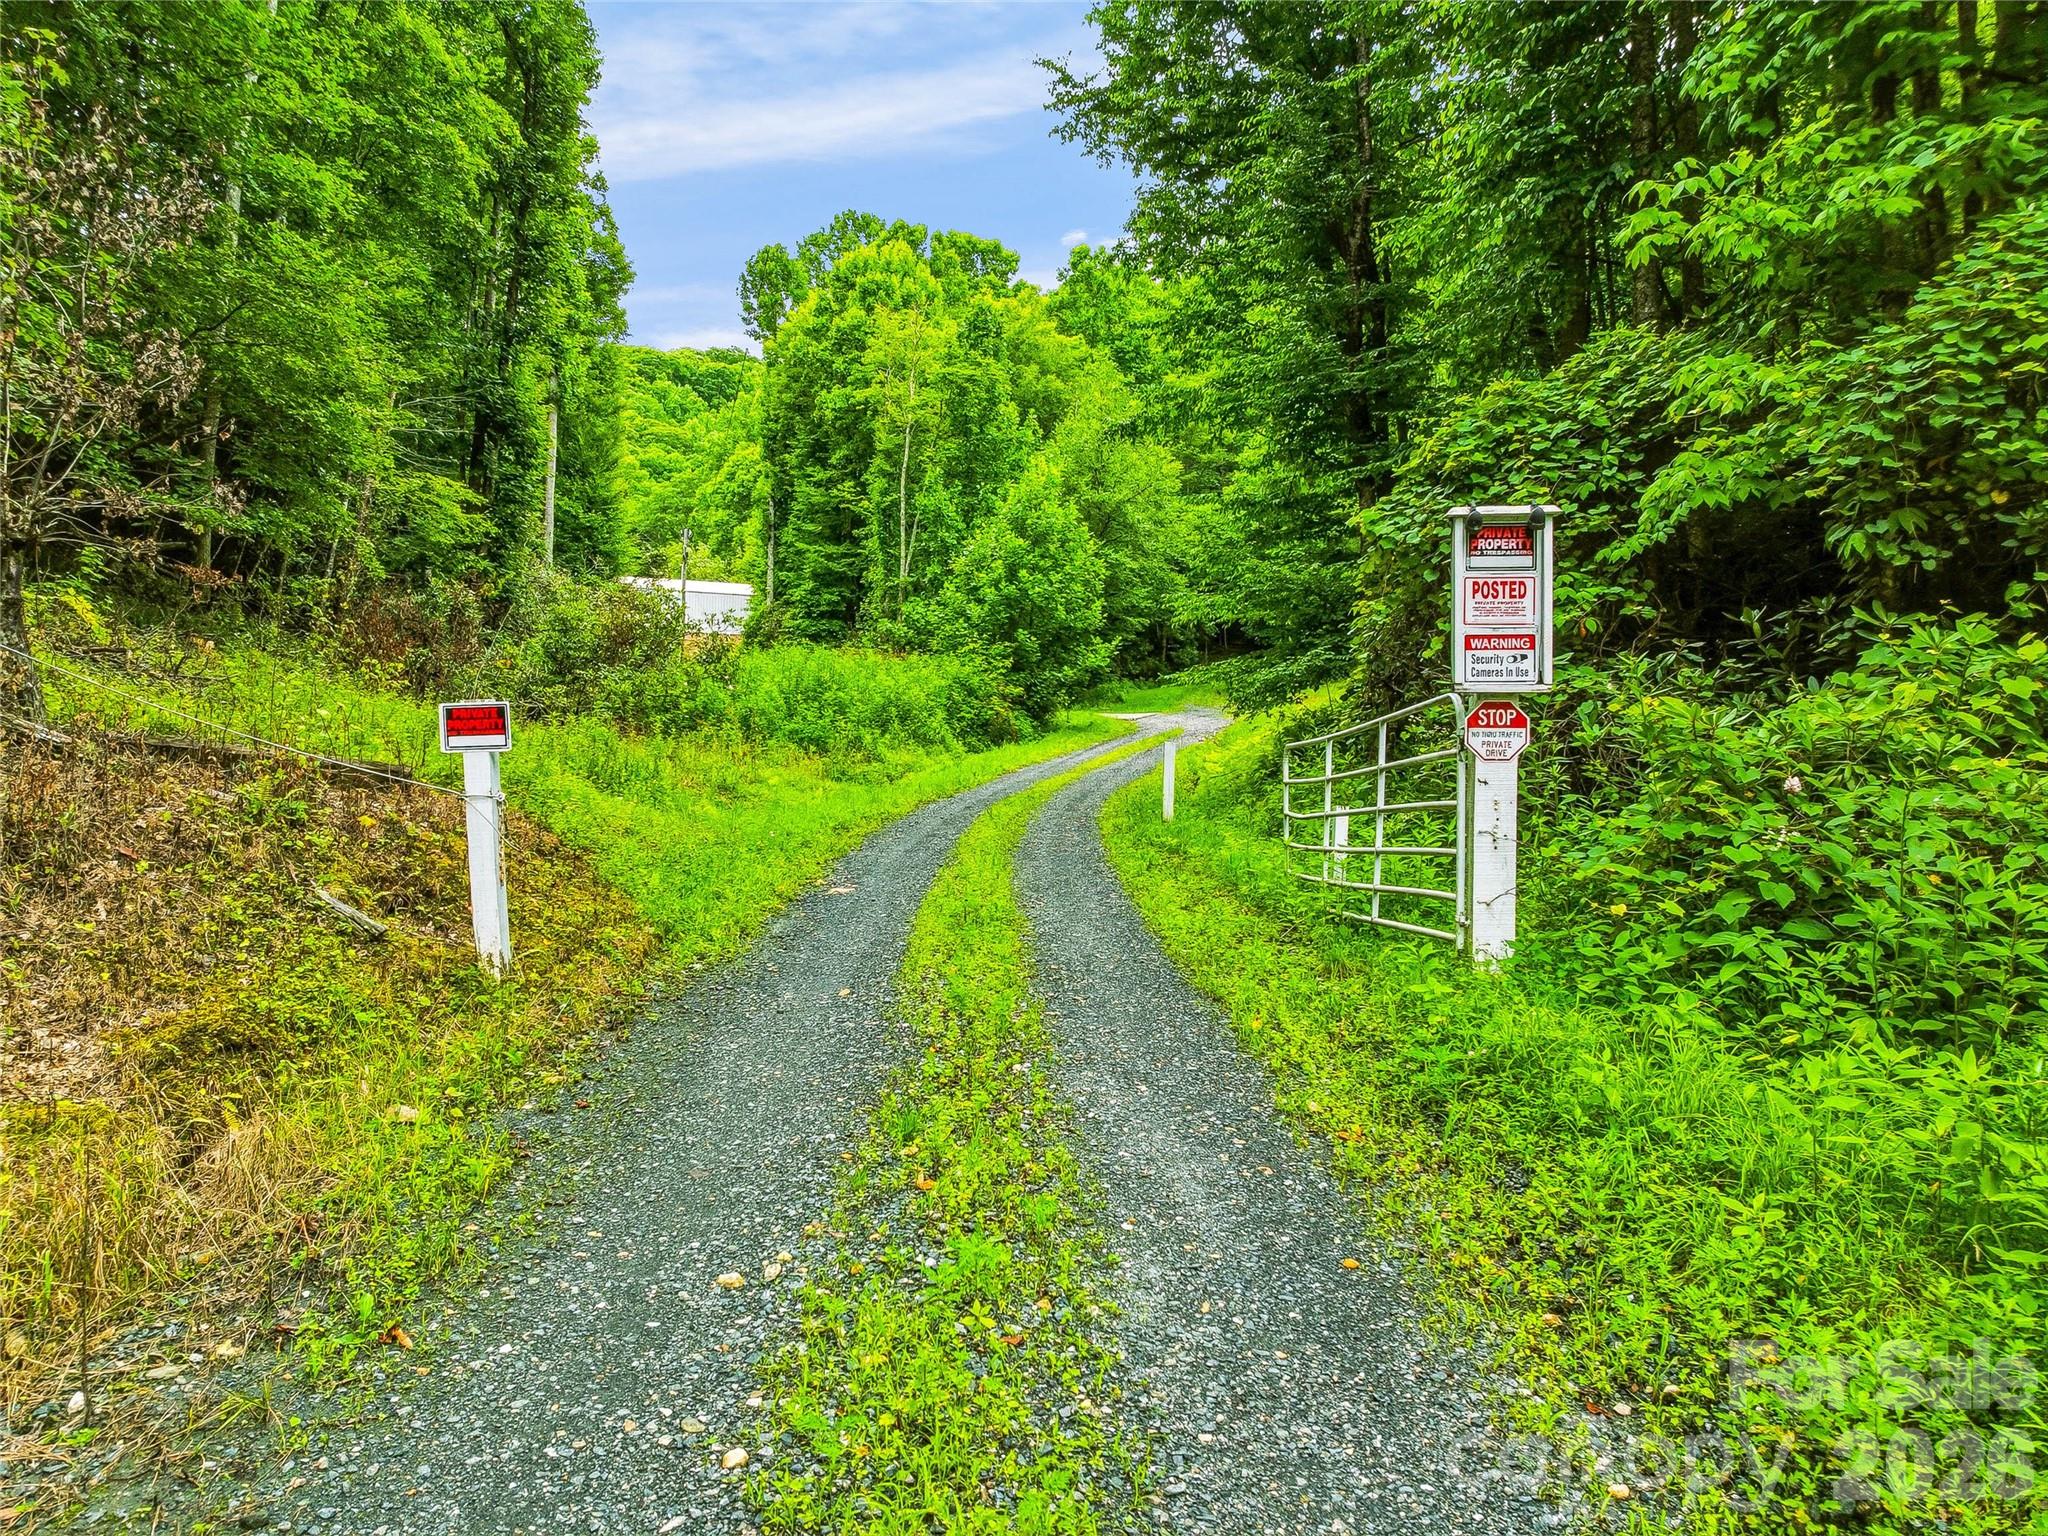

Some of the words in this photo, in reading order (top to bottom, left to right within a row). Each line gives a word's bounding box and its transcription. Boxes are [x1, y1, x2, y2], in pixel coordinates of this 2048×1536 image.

[1470, 538, 1532, 550] PROPERTY
[1472, 580, 1527, 599] POSTED
[1470, 638, 1531, 649] WARNING
[1471, 653, 1504, 666] Security
[1471, 667, 1503, 677] Cameras
[1505, 667, 1513, 677] In
[1515, 667, 1529, 677] Use
[452, 708, 498, 718] PRIVATE
[1478, 709, 1517, 726] STOP
[447, 718, 503, 730] PROPERTY
[1481, 740, 1512, 748] PRIVATE
[1485, 749, 1508, 757] DRIVE
